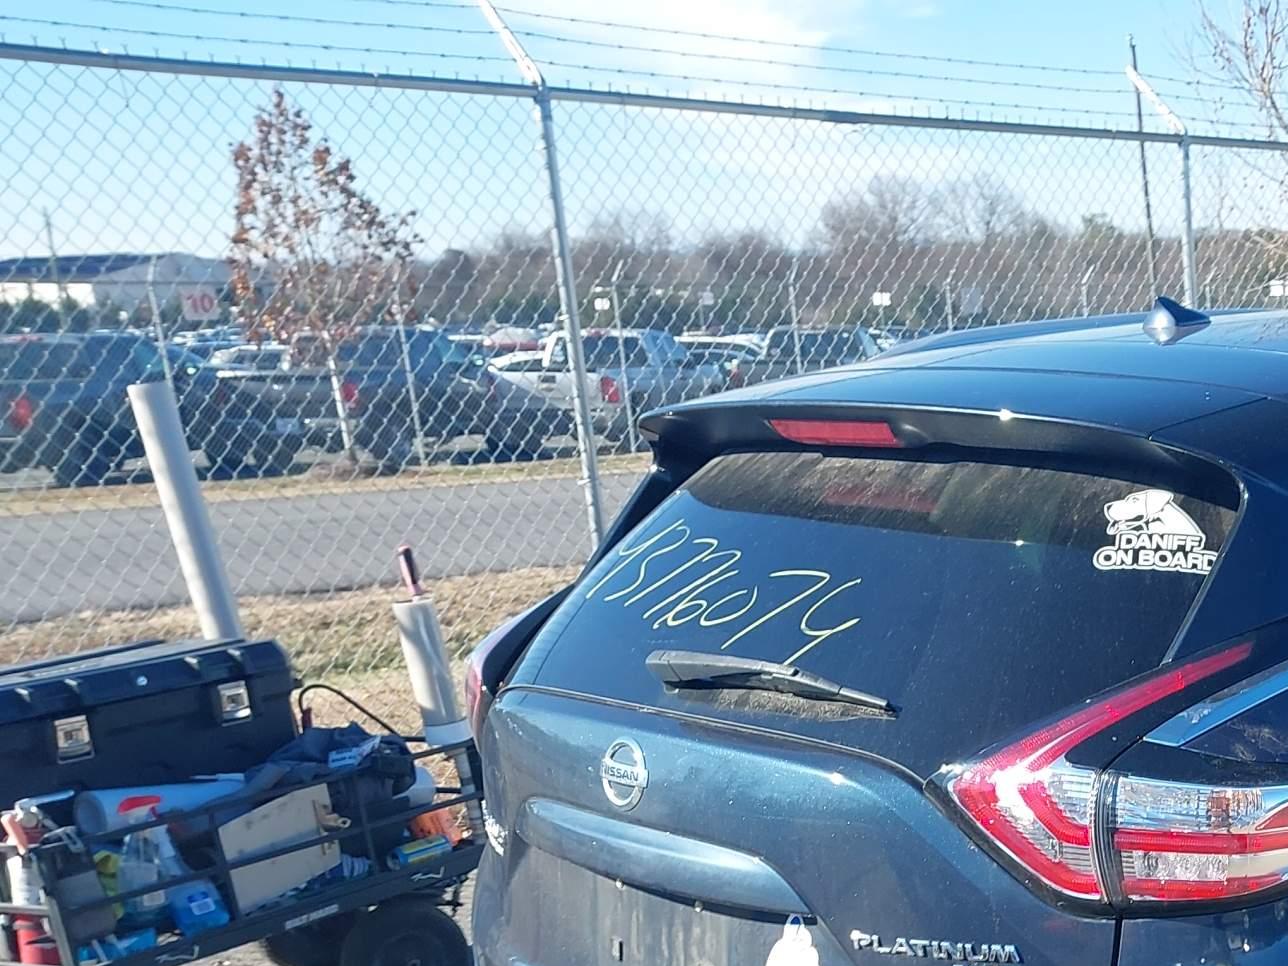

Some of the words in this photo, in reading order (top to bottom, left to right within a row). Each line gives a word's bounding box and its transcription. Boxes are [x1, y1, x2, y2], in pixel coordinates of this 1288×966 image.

[186, 293, 214, 314] 10
[1120, 533, 1201, 552] DANIFF
[1099, 549, 1133, 567] ON
[1138, 549, 1216, 571] BOARD
[602, 763, 639, 782] NISSAN
[849, 929, 1020, 963] PLATINUM
